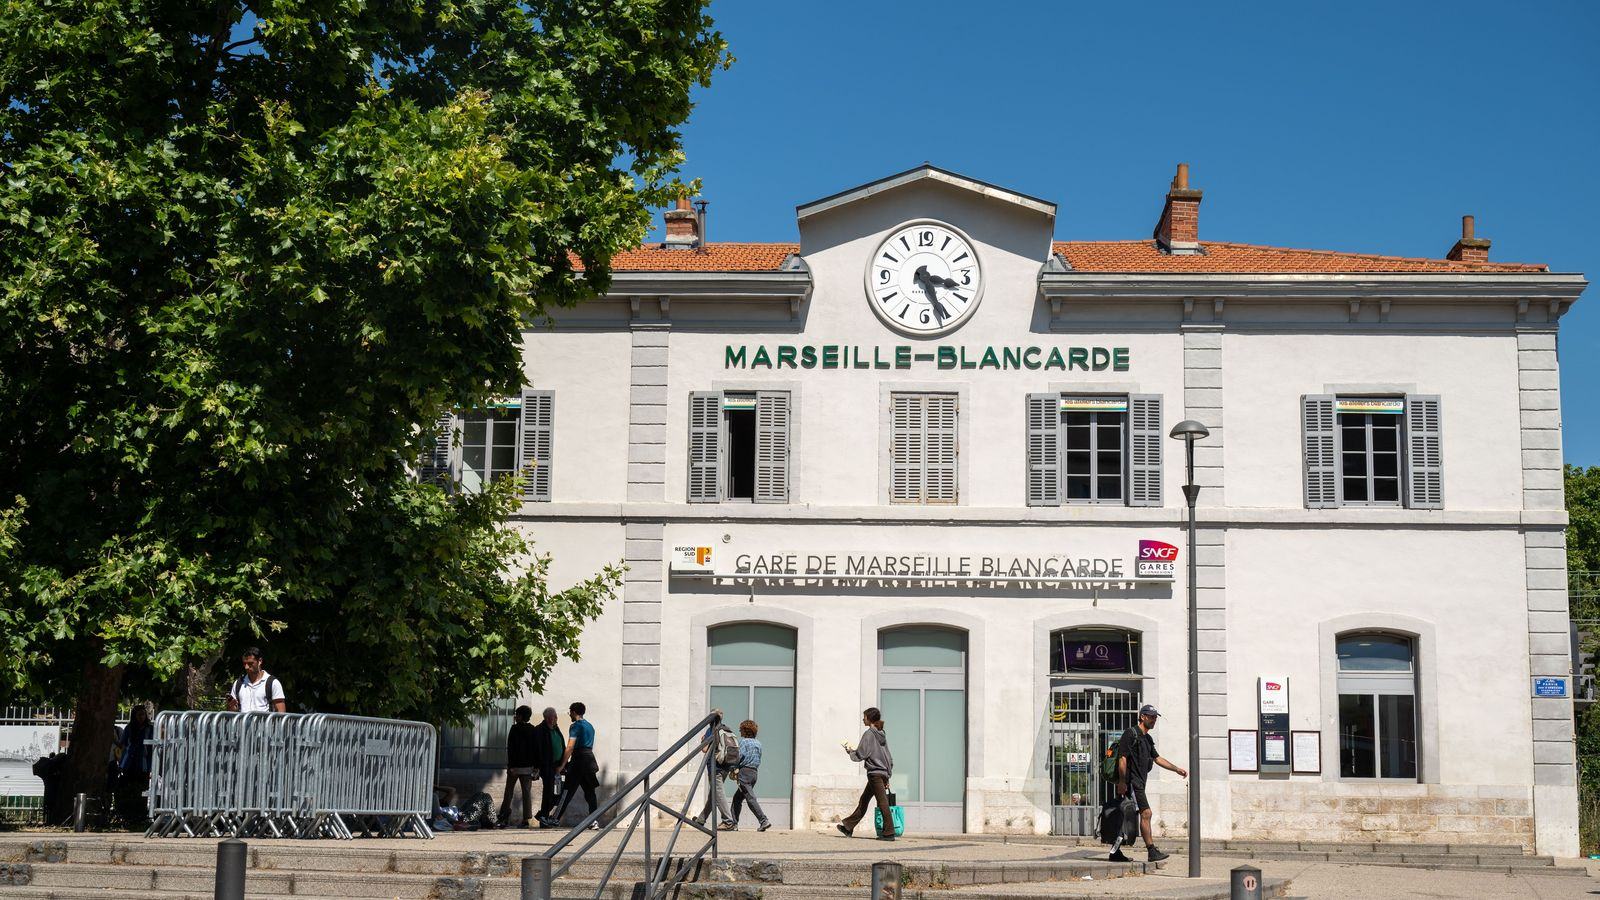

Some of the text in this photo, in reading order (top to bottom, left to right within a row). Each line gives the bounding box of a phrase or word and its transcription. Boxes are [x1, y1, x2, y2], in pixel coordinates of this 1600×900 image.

[918, 231, 934, 247] 12
[880, 269, 891, 285] 9
[960, 269, 971, 285] 3
[919, 309, 930, 324] 6
[725, 345, 1129, 371] MARSEILLE-BLANCARDE
[1141, 547, 1177, 558] SNCF
[736, 554, 1123, 577] GARE DE MARSEILLE BLANCARDE
[1140, 563, 1175, 571] GARES
